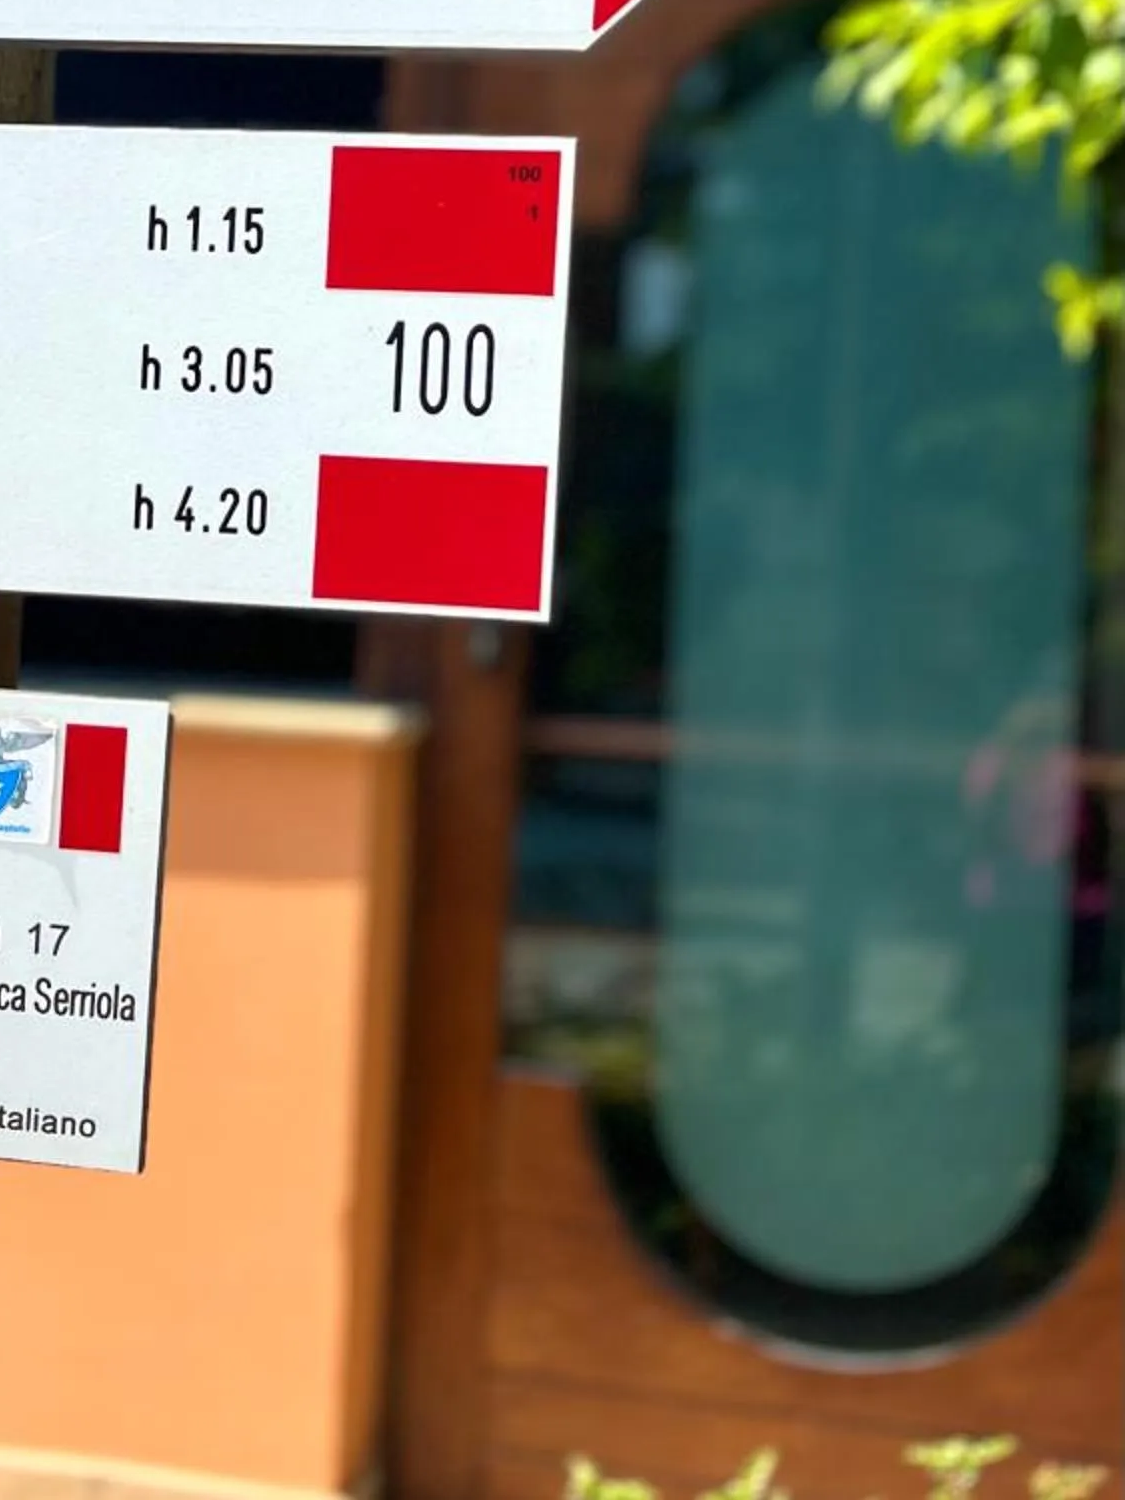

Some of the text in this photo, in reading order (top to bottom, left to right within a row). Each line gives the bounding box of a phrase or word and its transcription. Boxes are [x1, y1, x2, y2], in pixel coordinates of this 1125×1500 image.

[508, 165, 542, 182] 100
[147, 204, 264, 255] h 1.15
[140, 343, 274, 395] h 3.05
[385, 320, 496, 417] 100
[134, 483, 268, 536] h 4.20
[28, 922, 70, 956] 17
[33, 976, 136, 1022] Serriola
